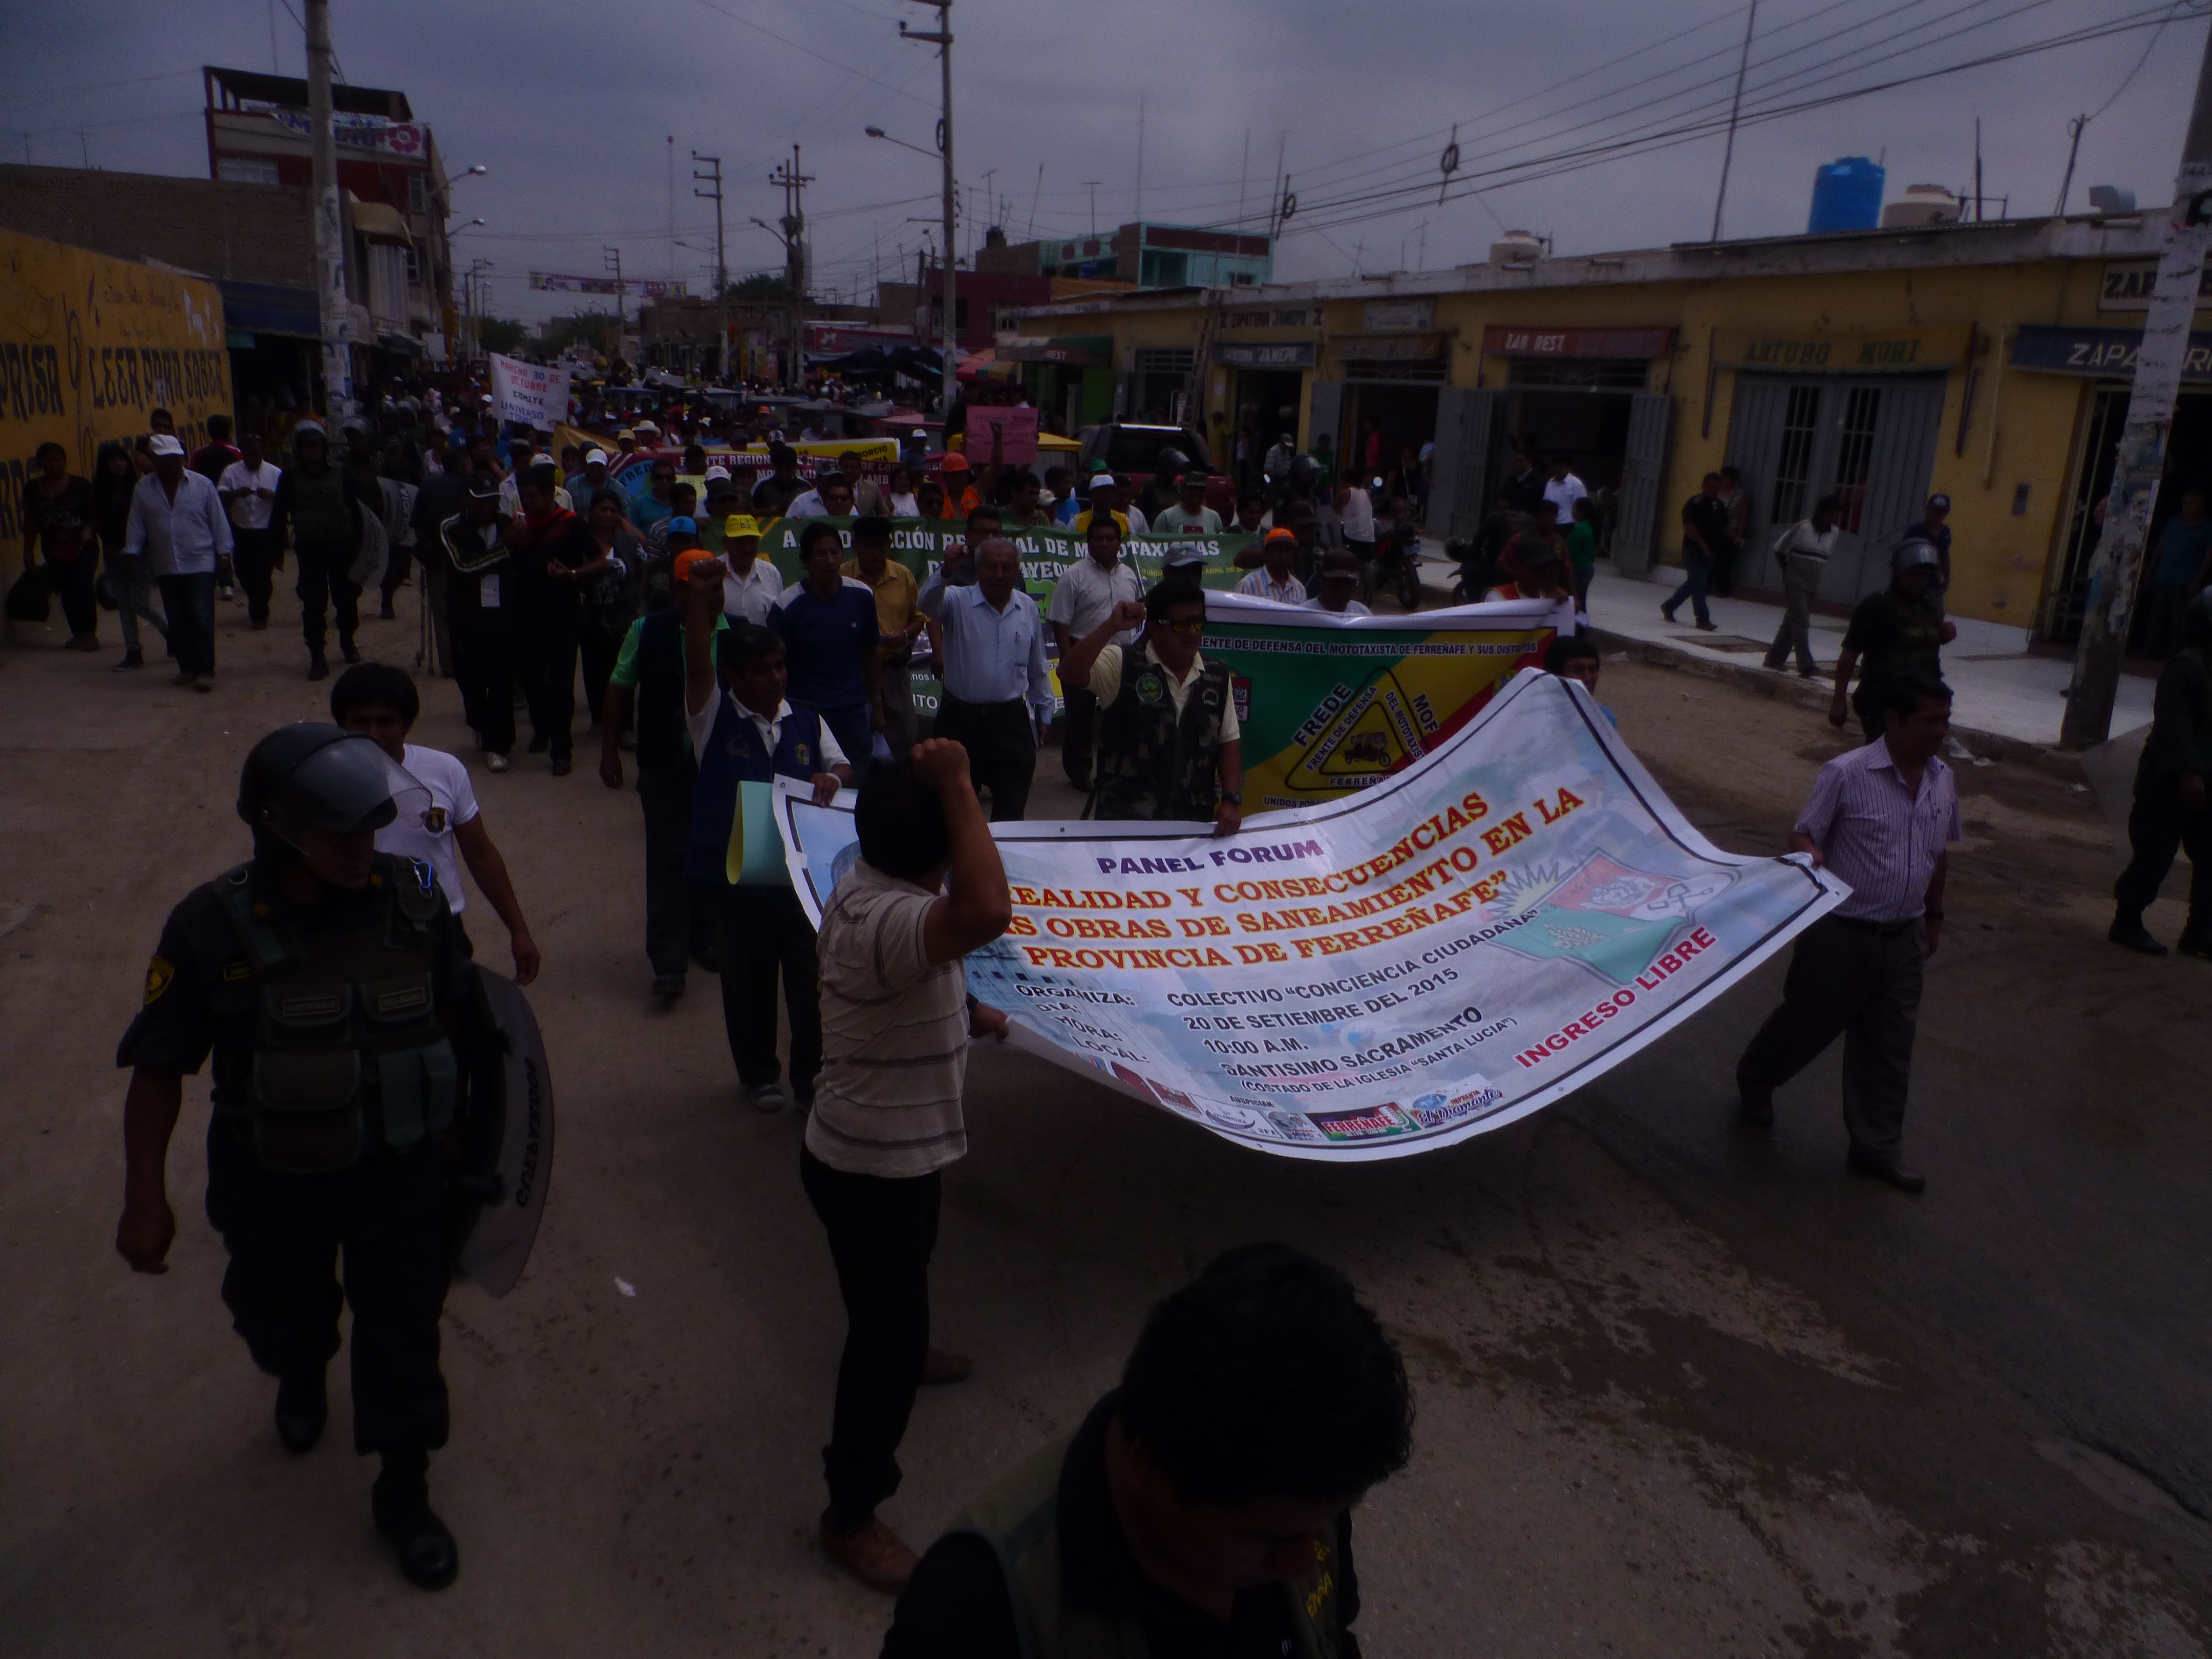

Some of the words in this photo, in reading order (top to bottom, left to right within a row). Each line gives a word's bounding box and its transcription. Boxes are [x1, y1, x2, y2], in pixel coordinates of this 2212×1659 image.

[1534, 335, 1565, 351] REST
[1745, 341, 1831, 365] ARTURO
[1858, 339, 1921, 364] MORI
[89, 348, 143, 412] LEER
[141, 347, 183, 408] PARA
[549, 374, 560, 383] DE
[730, 454, 772, 466] REGION
[621, 464, 653, 486] FRED
[1045, 538, 1069, 556] DE
[1235, 639, 1249, 649] DE
[1253, 640, 1302, 652] DEFENSA
[1305, 642, 1325, 654] DEL
[1330, 643, 1397, 655] MOTOTAXISTA
[1400, 644, 1411, 654] DE
[1414, 643, 1465, 655] FERREÑAFE
[1469, 644, 1474, 654] Y
[1477, 644, 1495, 655] SUS
[1385, 691, 1399, 711] DEL
[1412, 694, 1439, 733] MOF
[1292, 684, 1352, 747] FREDE
[1306, 736, 1336, 771] FRENTE
[1333, 722, 1346, 738] DE
[1344, 686, 1377, 725] DEFENSA
[1264, 796, 1297, 808] UNIDOS
[1047, 917, 1173, 939] OBRAS
[1176, 915, 1231, 938] DE
[1237, 845, 1478, 933] SANEAMIENTO
[1480, 811, 1533, 857] EN
[1534, 786, 1584, 825] LA
[1097, 856, 1205, 874] PANEL
[1209, 839, 1324, 867] FORUM
[1176, 887, 1204, 908] Y
[1214, 792, 1489, 904] CONSECUENCIAS
[1022, 945, 1233, 970] PROVINCIA
[1233, 942, 1291, 965] DE
[1016, 985, 1136, 1006] ORGANIZA:
[1167, 986, 1284, 1007] COLECTIVO
[1183, 1016, 1211, 1030] 20
[1214, 1015, 1245, 1030] DE
[1246, 1004, 1364, 1029] SETIEMBRE
[1364, 990, 1409, 1013] DEL
[1409, 968, 1459, 998] 2015
[1515, 989, 1636, 1069] INGRESO
[1635, 926, 1716, 991] LIBRE
[1054, 1015, 1123, 1042] HORA:
[1221, 1058, 1338, 1077] SANTISIMO
[1340, 1006, 1483, 1069] SACRAMENTO
[1072, 1035, 1151, 1064] LOCAL:
[1203, 1038, 1259, 1055] 10:00
[1264, 1037, 1309, 1054] A.M.
[1242, 1080, 1310, 1094] (COSTADO
[1311, 1079, 1333, 1092] DE
[1334, 1077, 1355, 1089] LA
[1354, 1064, 1411, 1086] IGLESIA
[1322, 1115, 1396, 1132] FERREÑAFE
